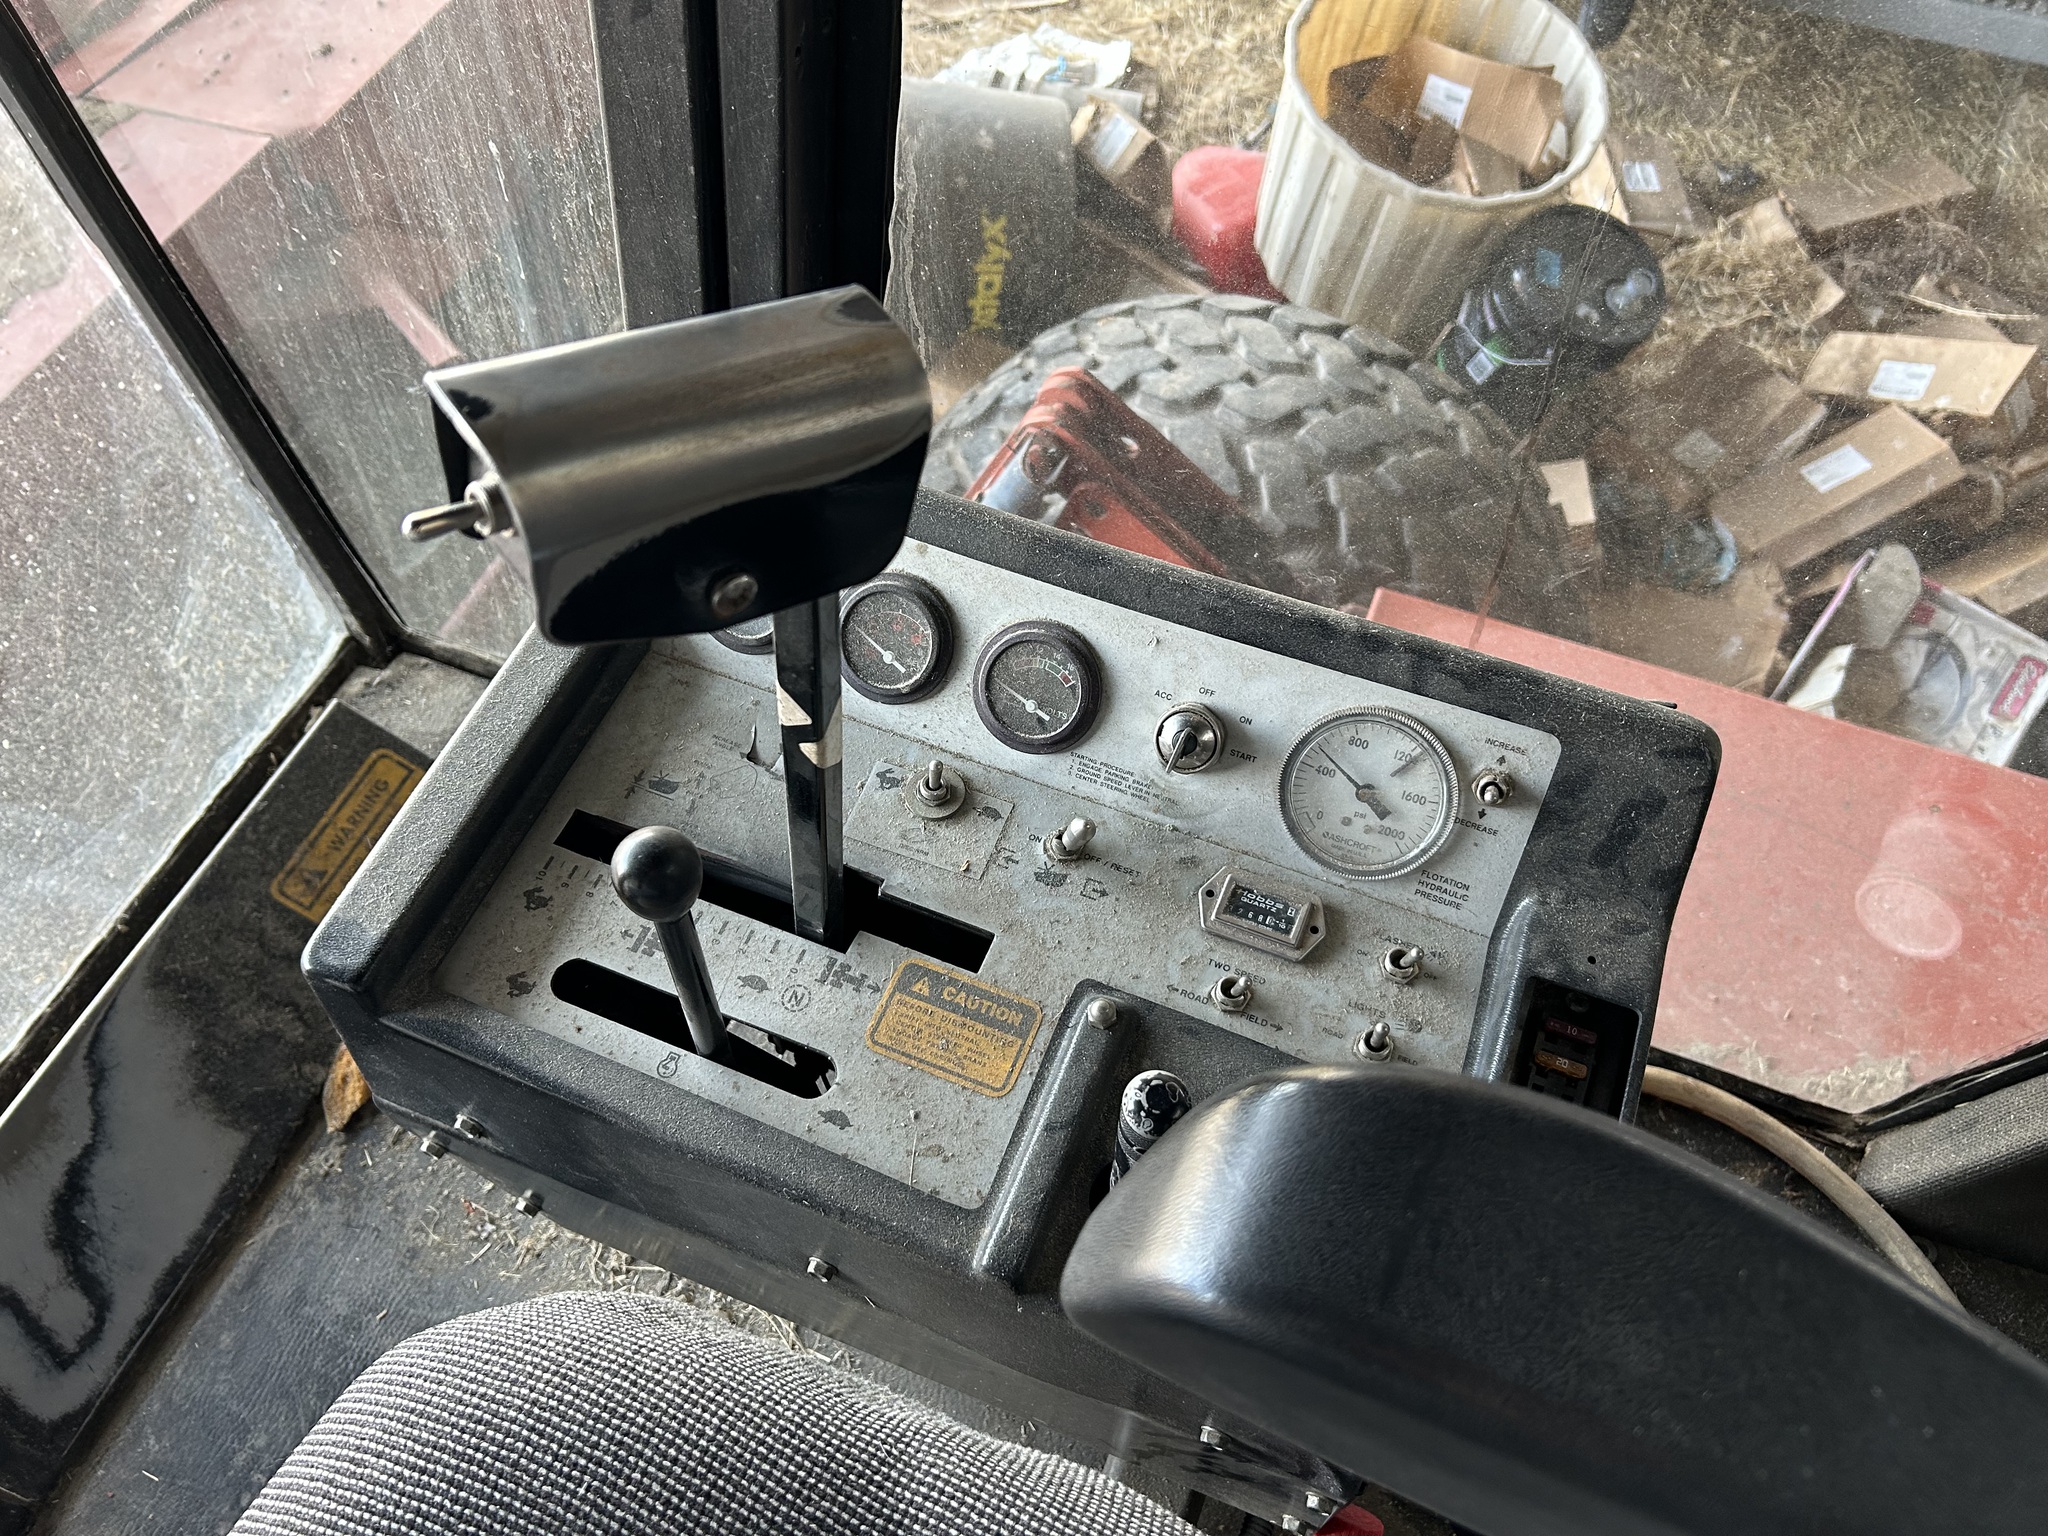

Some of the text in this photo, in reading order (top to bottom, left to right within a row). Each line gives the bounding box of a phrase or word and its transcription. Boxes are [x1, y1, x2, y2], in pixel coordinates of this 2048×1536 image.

[1154, 689, 1173, 701] ACC
[1198, 686, 1216, 698] OFF
[1239, 715, 1253, 726] ON
[1348, 735, 1369, 750] 800
[1484, 737, 1528, 756] INCREASE
[1070, 751, 1098, 765] STARTING
[1229, 748, 1258, 764] START
[1104, 769, 1130, 782] PARKING
[1315, 764, 1336, 779] 400
[1075, 773, 1098, 785] CENTER
[1099, 781, 1128, 796] STEERING
[1076, 767, 1101, 779] GROUND
[1103, 776, 1123, 787] SPEED
[1124, 784, 1143, 794] LEVER
[1401, 789, 1427, 806] 1600
[328, 778, 390, 851] WARNING
[1316, 810, 1324, 820] 0
[1353, 811, 1367, 820] psi
[1377, 824, 1406, 841] 2000
[1454, 818, 1499, 836] DECREASE
[1028, 833, 1042, 843] ON
[1083, 853, 1102, 864] OFF
[1110, 862, 1141, 877] RESET
[535, 870, 547, 881] 10
[1420, 869, 1470, 892] FLOTATION
[1417, 879, 1470, 902] HYDRAULIC
[1240, 896, 1278, 913] QUARTZ
[1413, 888, 1463, 911] PRESSURE
[1208, 958, 1267, 985] TWO SPEED
[1180, 989, 1209, 1005] ROAD
[942, 985, 1023, 1026] CAUTION
[1347, 1000, 1387, 1019] LIGHTS
[1240, 1011, 1268, 1027] FIELD
[941, 1014, 1015, 1048] DISMOUNTING
[1321, 1027, 1344, 1039] ROAD
[1566, 1025, 1578, 1036] 10
[1555, 1057, 1569, 1069] 20
